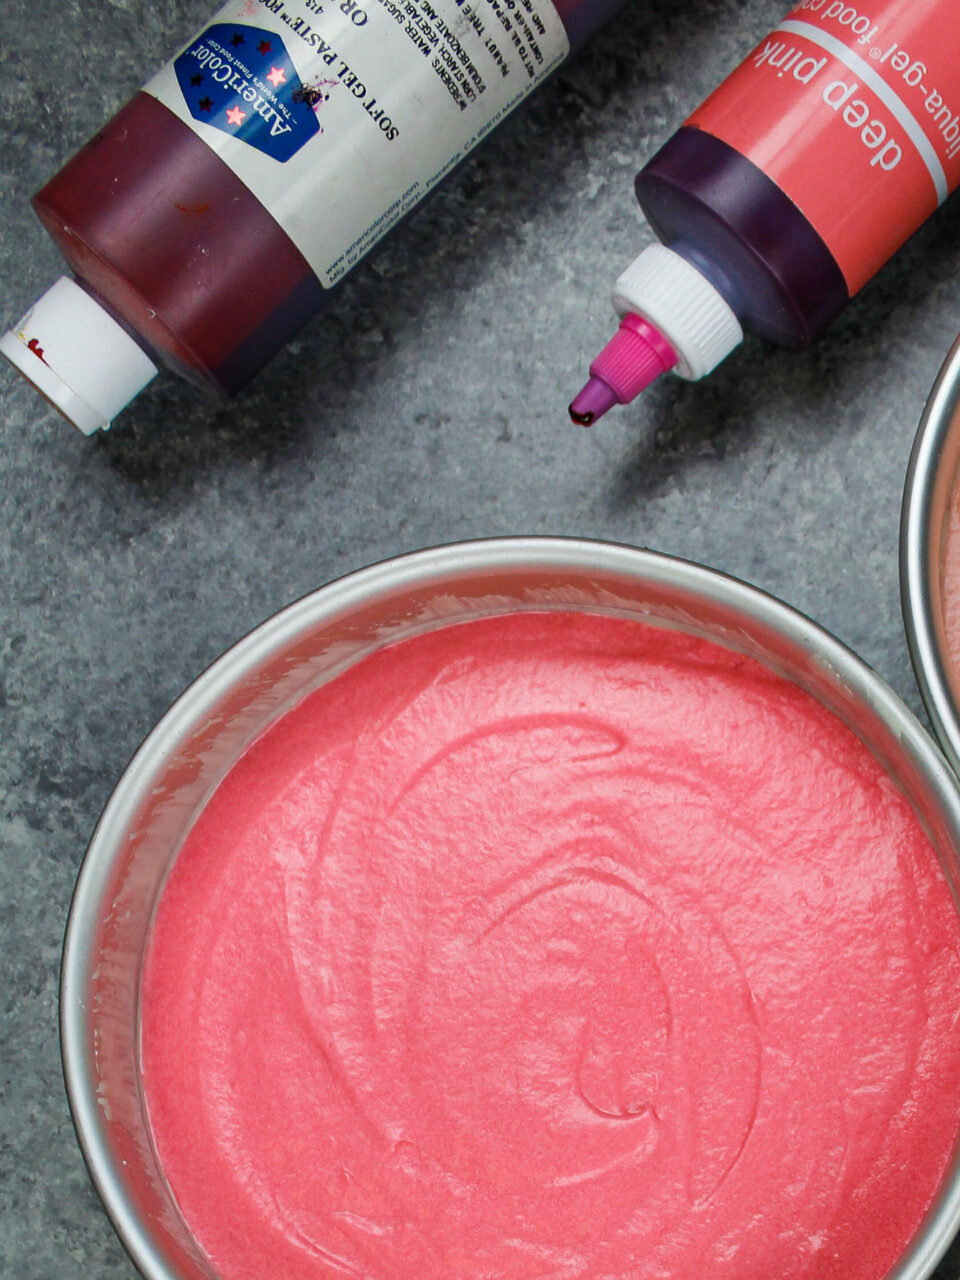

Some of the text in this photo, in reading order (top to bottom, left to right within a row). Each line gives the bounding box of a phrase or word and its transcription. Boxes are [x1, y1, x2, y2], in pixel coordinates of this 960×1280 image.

[461, 4, 486, 37] TREE
[820, 0, 880, 46] food
[434, 18, 471, 66] BENZOATE
[518, 45, 529, 62] TO
[233, 58, 254, 79] Finest
[337, 61, 368, 99] GEL
[252, 76, 278, 104] World's
[753, 40, 903, 172] deep pink
[278, 103, 292, 120] The
[362, 98, 400, 142] SOFT
